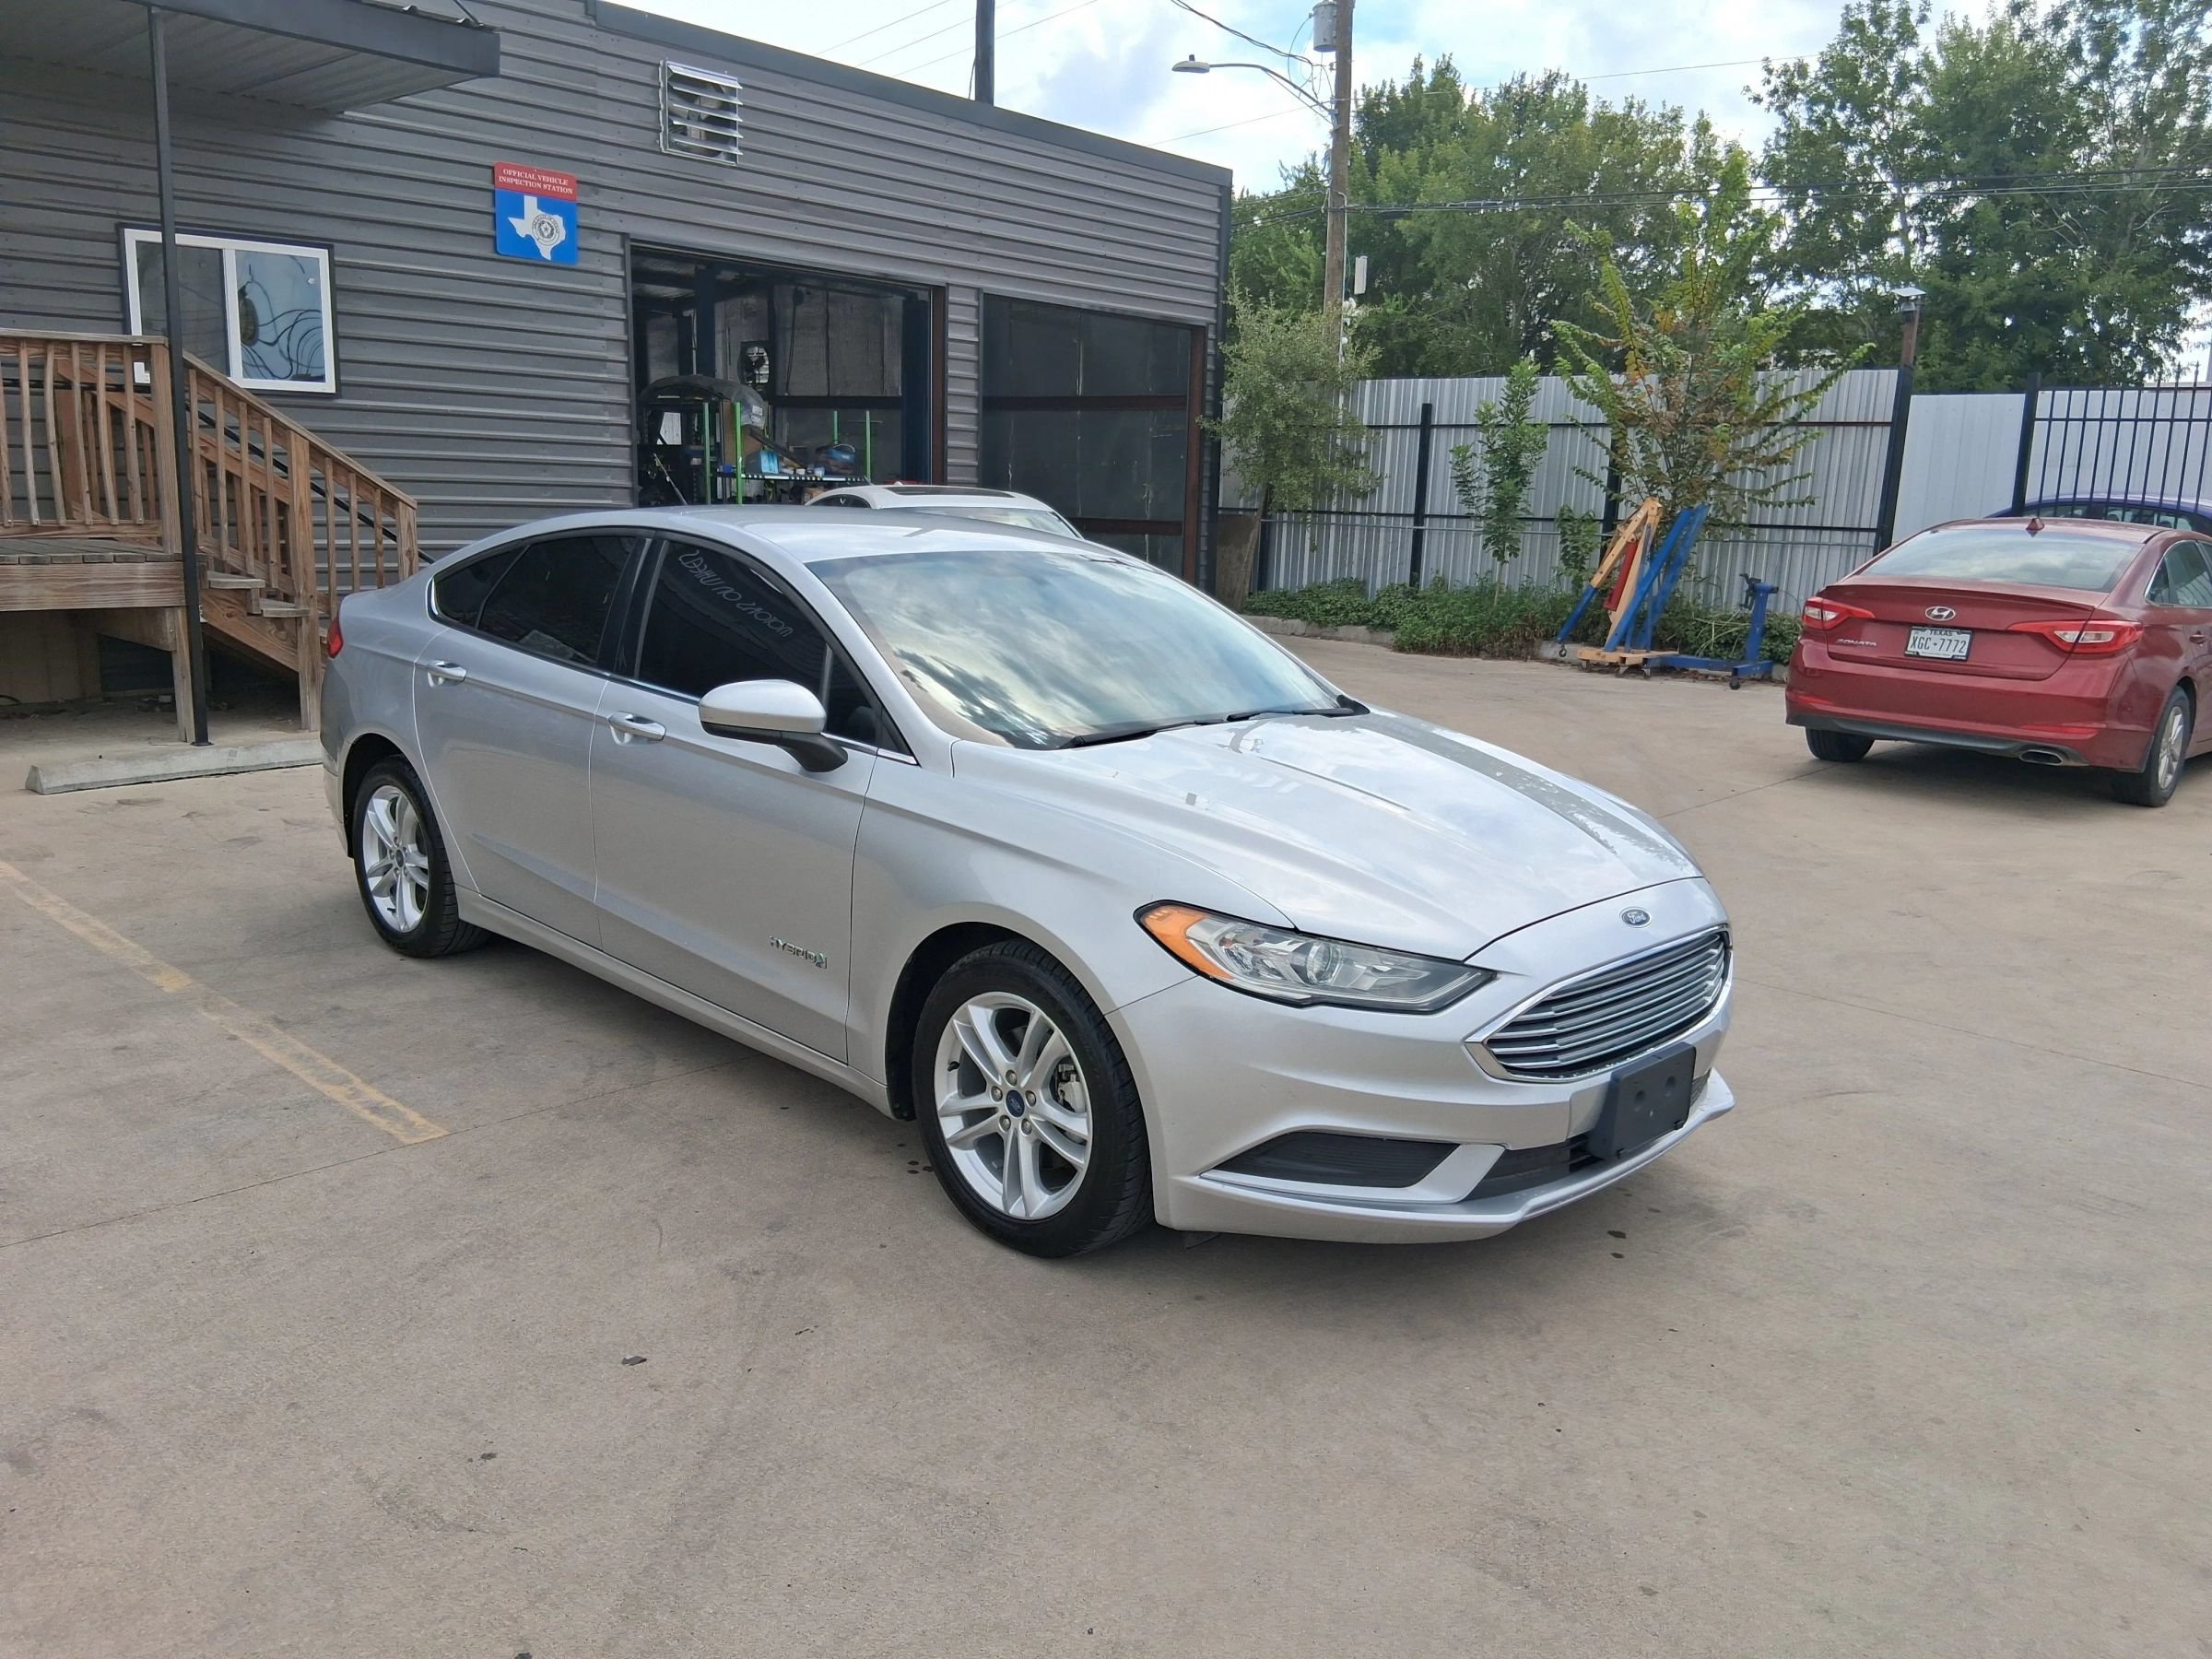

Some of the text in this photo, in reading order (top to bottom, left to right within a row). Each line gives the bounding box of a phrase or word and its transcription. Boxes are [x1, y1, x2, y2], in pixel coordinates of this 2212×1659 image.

[499, 176, 573, 194] INSPECTION STATION
[503, 169, 569, 186] OFFICIAL VEHICLE
[1910, 635, 1967, 653] XGC 7772
